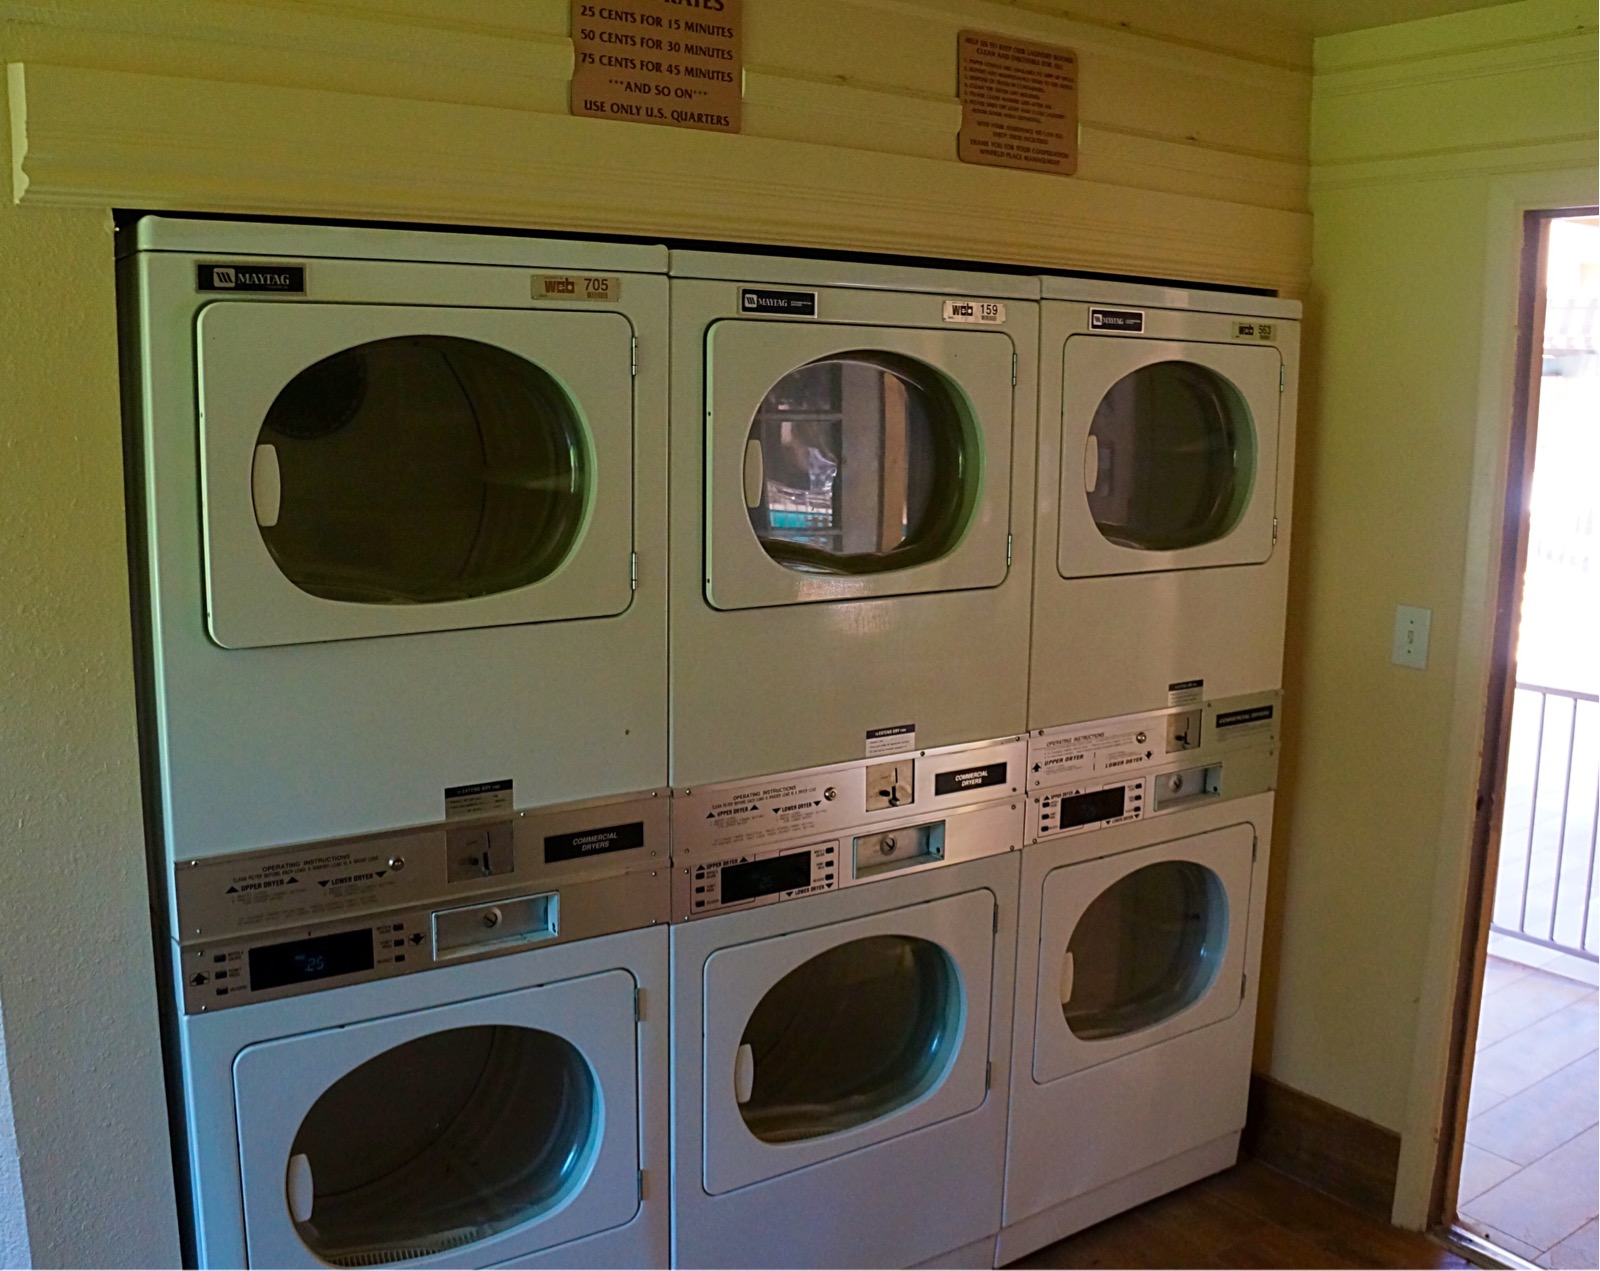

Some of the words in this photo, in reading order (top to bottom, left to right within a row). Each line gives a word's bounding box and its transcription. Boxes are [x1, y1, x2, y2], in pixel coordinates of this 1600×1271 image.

[581, 5, 595, 17] 25
[599, 8, 637, 24] CENTS
[640, 14, 663, 27] FOR
[668, 19, 681, 30] 15
[684, 21, 734, 38] MINUTES
[581, 29, 595, 41] 50
[599, 31, 637, 47] CENTS
[640, 37, 663, 50] FOR
[667, 41, 681, 53] 30
[684, 43, 733, 60] MINUTES
[581, 52, 595, 64] 75
[599, 54, 637, 69] CENTS
[640, 60, 663, 73] FOR
[666, 64, 681, 75] 45
[684, 66, 733, 83] MINUTES
[655, 85, 671, 97] SO
[584, 99, 606, 112] USE
[610, 102, 642, 116] ONLY
[645, 106, 667, 119] U.S.
[671, 109, 730, 127] QUARTERS
[237, 273, 290, 285] MAYTAG
[544, 277, 575, 294] web
[584, 278, 609, 291] 705
[758, 298, 788, 307] MAYTAG
[952, 302, 973, 316] web
[980, 304, 999, 316] 159
[1044, 756, 1063, 766] UPPER
[1065, 754, 1084, 762] DRYER
[1105, 760, 1124, 769] LOWER
[955, 770, 989, 781] COMMERCIAL
[961, 777, 982, 787] DRYERS
[733, 789, 760, 800] OPERATING
[762, 785, 797, 796] INSTRUCTIONS
[716, 809, 733, 817] UPPER
[733, 806, 748, 814] DRYER
[781, 804, 797, 812] LOWER
[572, 831, 618, 846] COMMERCIAL
[581, 840, 610, 852] DRYERS
[262, 860, 301, 872] OPERATING
[303, 853, 351, 867] INSTRUCTIONS
[706, 861, 721, 870] UPPER
[722, 859, 738, 867] DRYER
[241, 880, 262, 892] UPPER
[263, 878, 285, 888] DRYER
[331, 875, 353, 886] LOWER
[353, 872, 374, 882] DRYER
[794, 887, 810, 896] LOWER
[810, 884, 825, 893] DRYER
